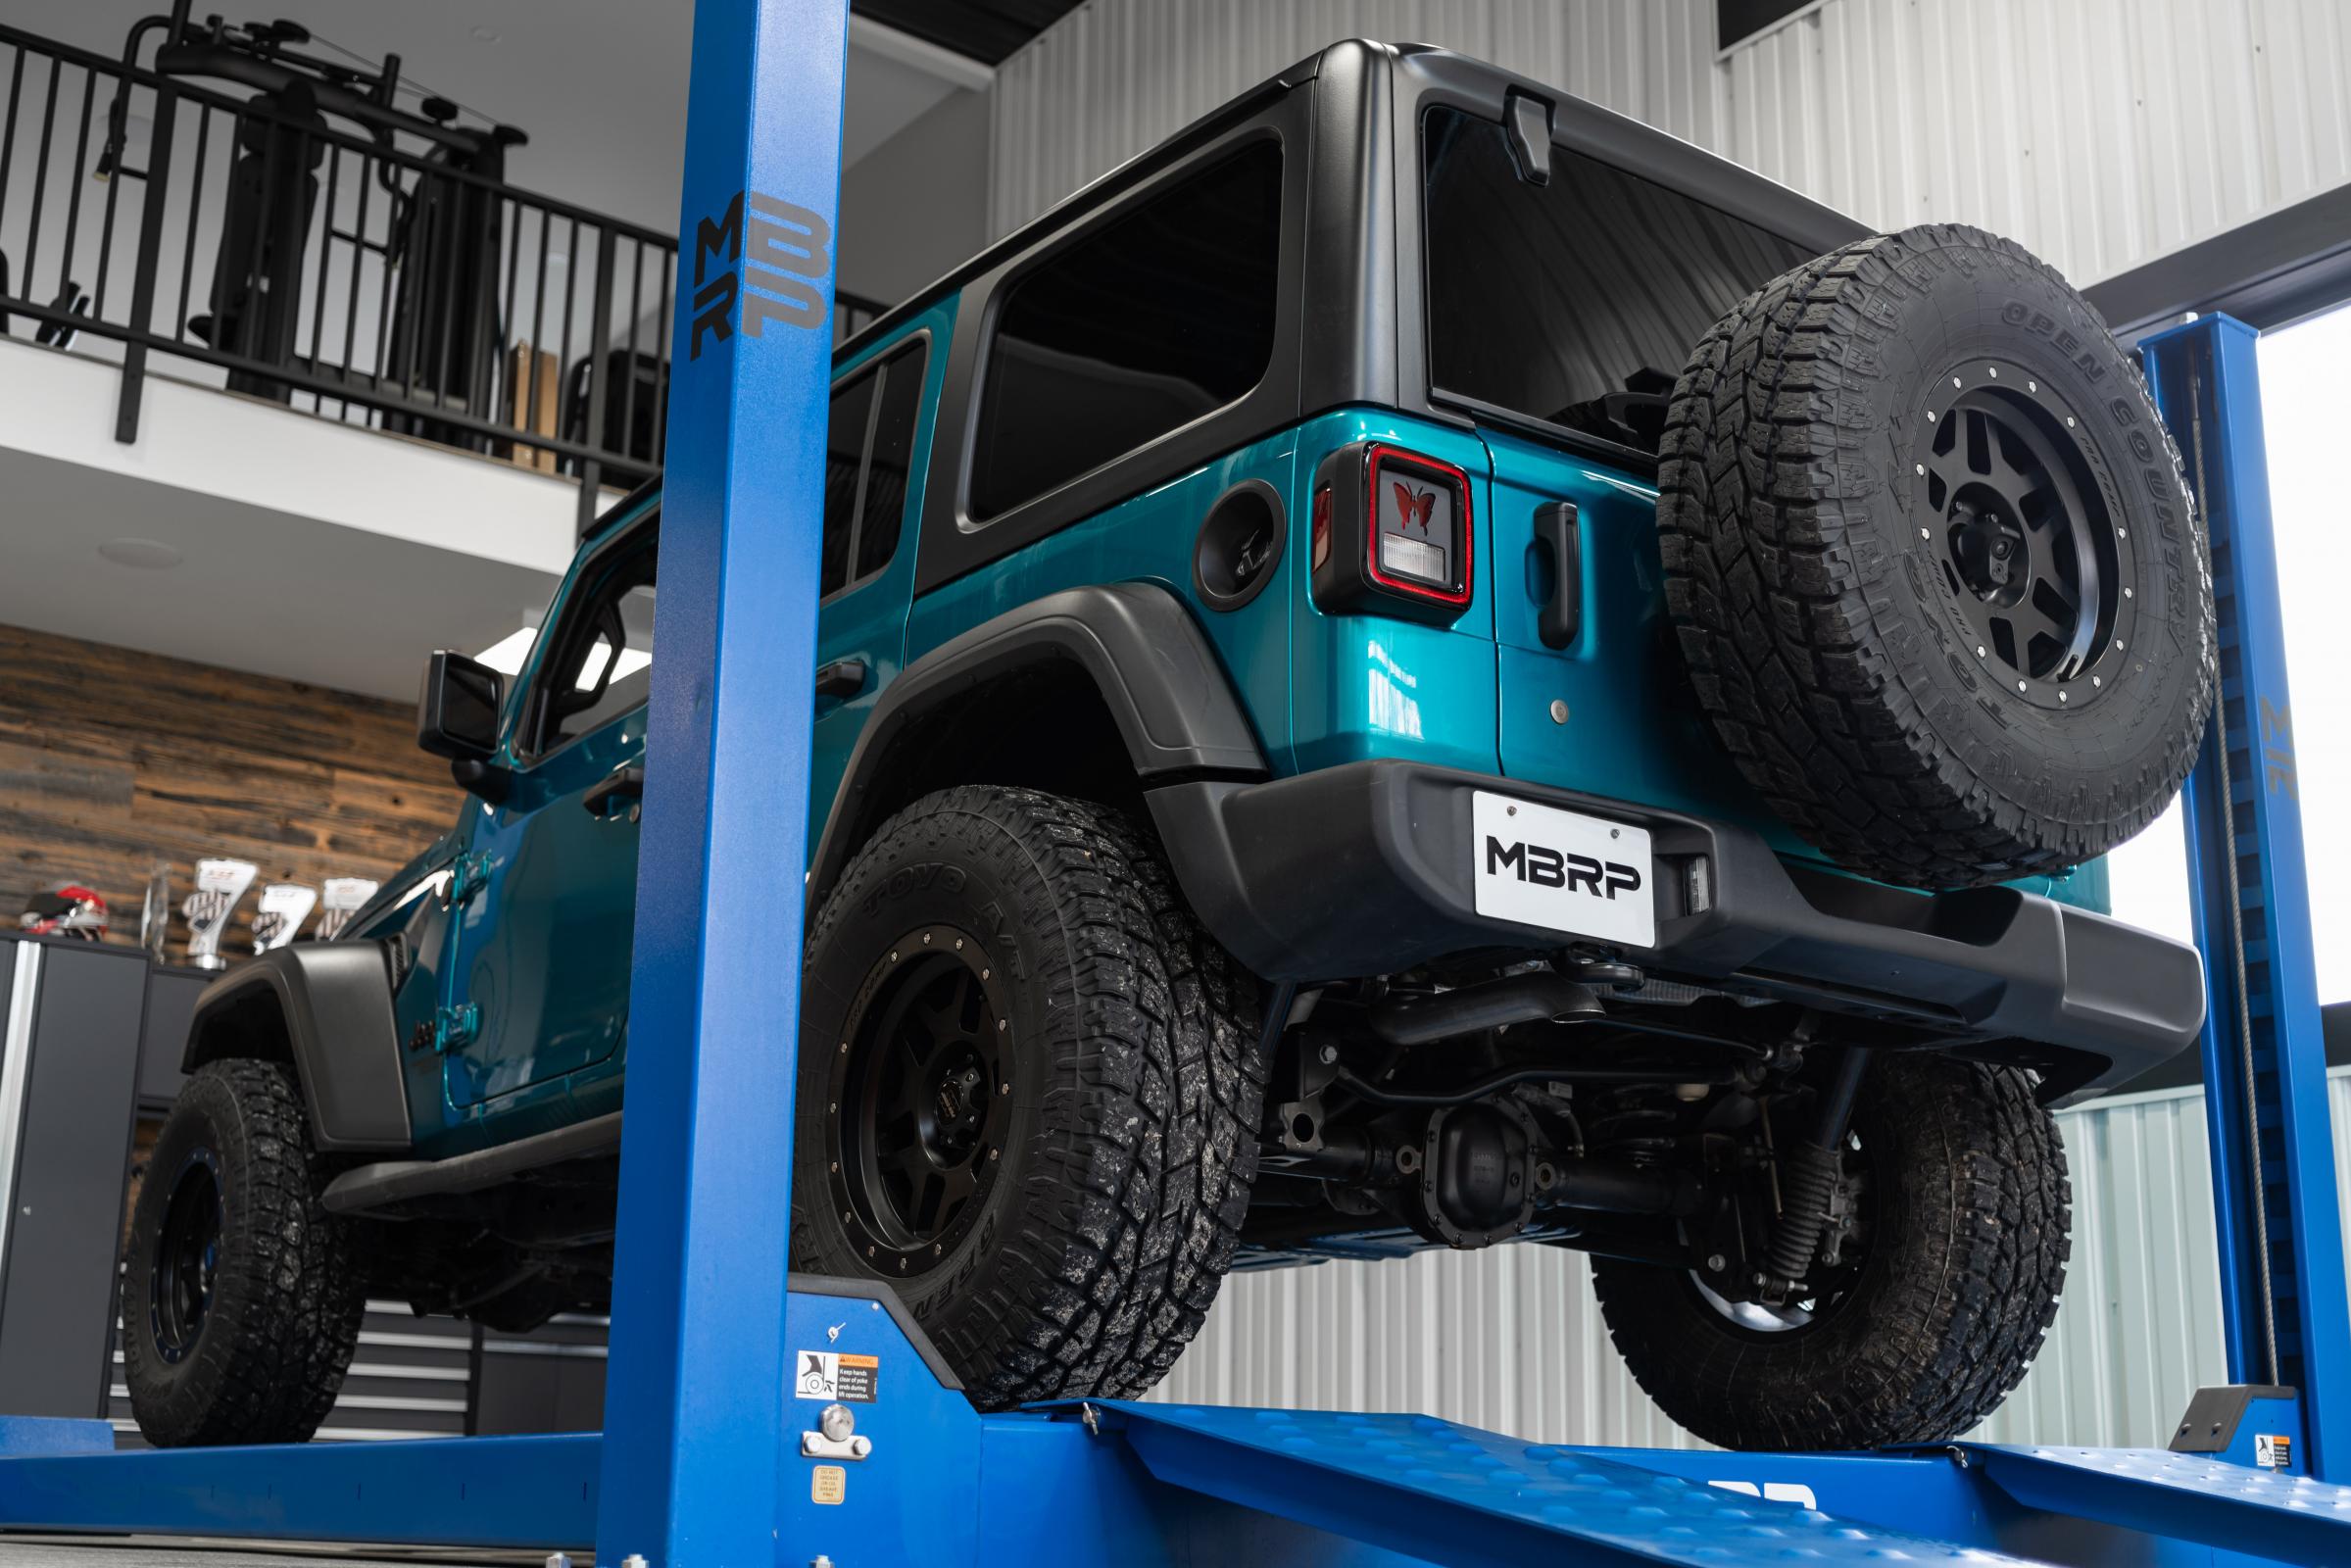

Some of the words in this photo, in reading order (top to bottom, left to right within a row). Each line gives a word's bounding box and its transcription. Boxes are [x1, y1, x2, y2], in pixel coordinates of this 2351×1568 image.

[2000, 300, 2107, 385] OPEN
[2110, 397, 2187, 659] COUNTRY
[862, 861, 967, 919] TOYO
[1486, 834, 1641, 901] MBRP
[912, 1213, 996, 1322] OPEN
[846, 1356, 875, 1365] WARNING
